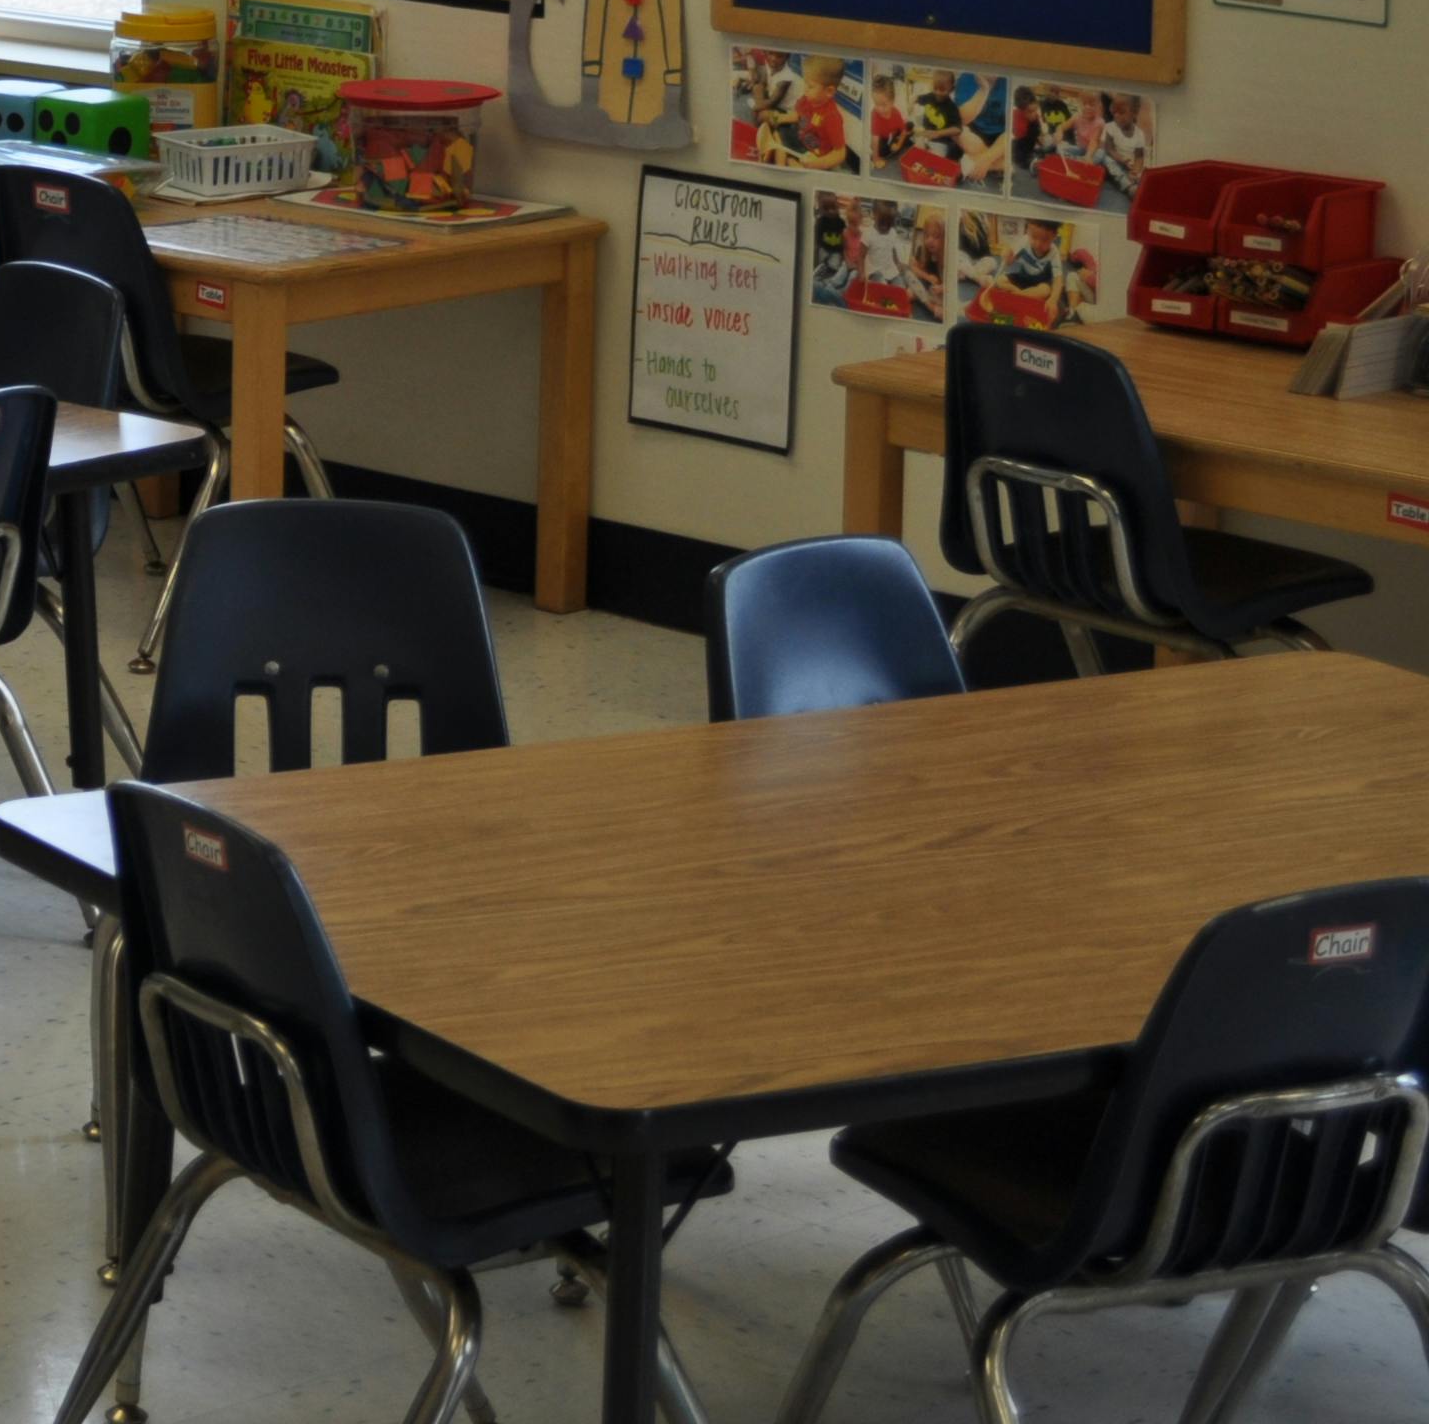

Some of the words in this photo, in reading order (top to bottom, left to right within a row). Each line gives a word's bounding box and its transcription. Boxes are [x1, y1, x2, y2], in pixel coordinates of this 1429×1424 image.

[246, 48, 271, 67] Five
[274, 52, 304, 72] Little
[307, 57, 359, 80] Monsters
[38, 190, 64, 206] Chair
[674, 181, 763, 222] Classroom
[691, 215, 739, 248] Rules
[201, 287, 223, 302] Table
[703, 307, 751, 336] voices
[701, 357, 717, 382] to
[1020, 348, 1055, 369] Chair
[664, 384, 740, 420] ourselves
[1393, 503, 1428, 522] Table
[188, 831, 221, 866] Chair
[1315, 931, 1370, 957] Chair
